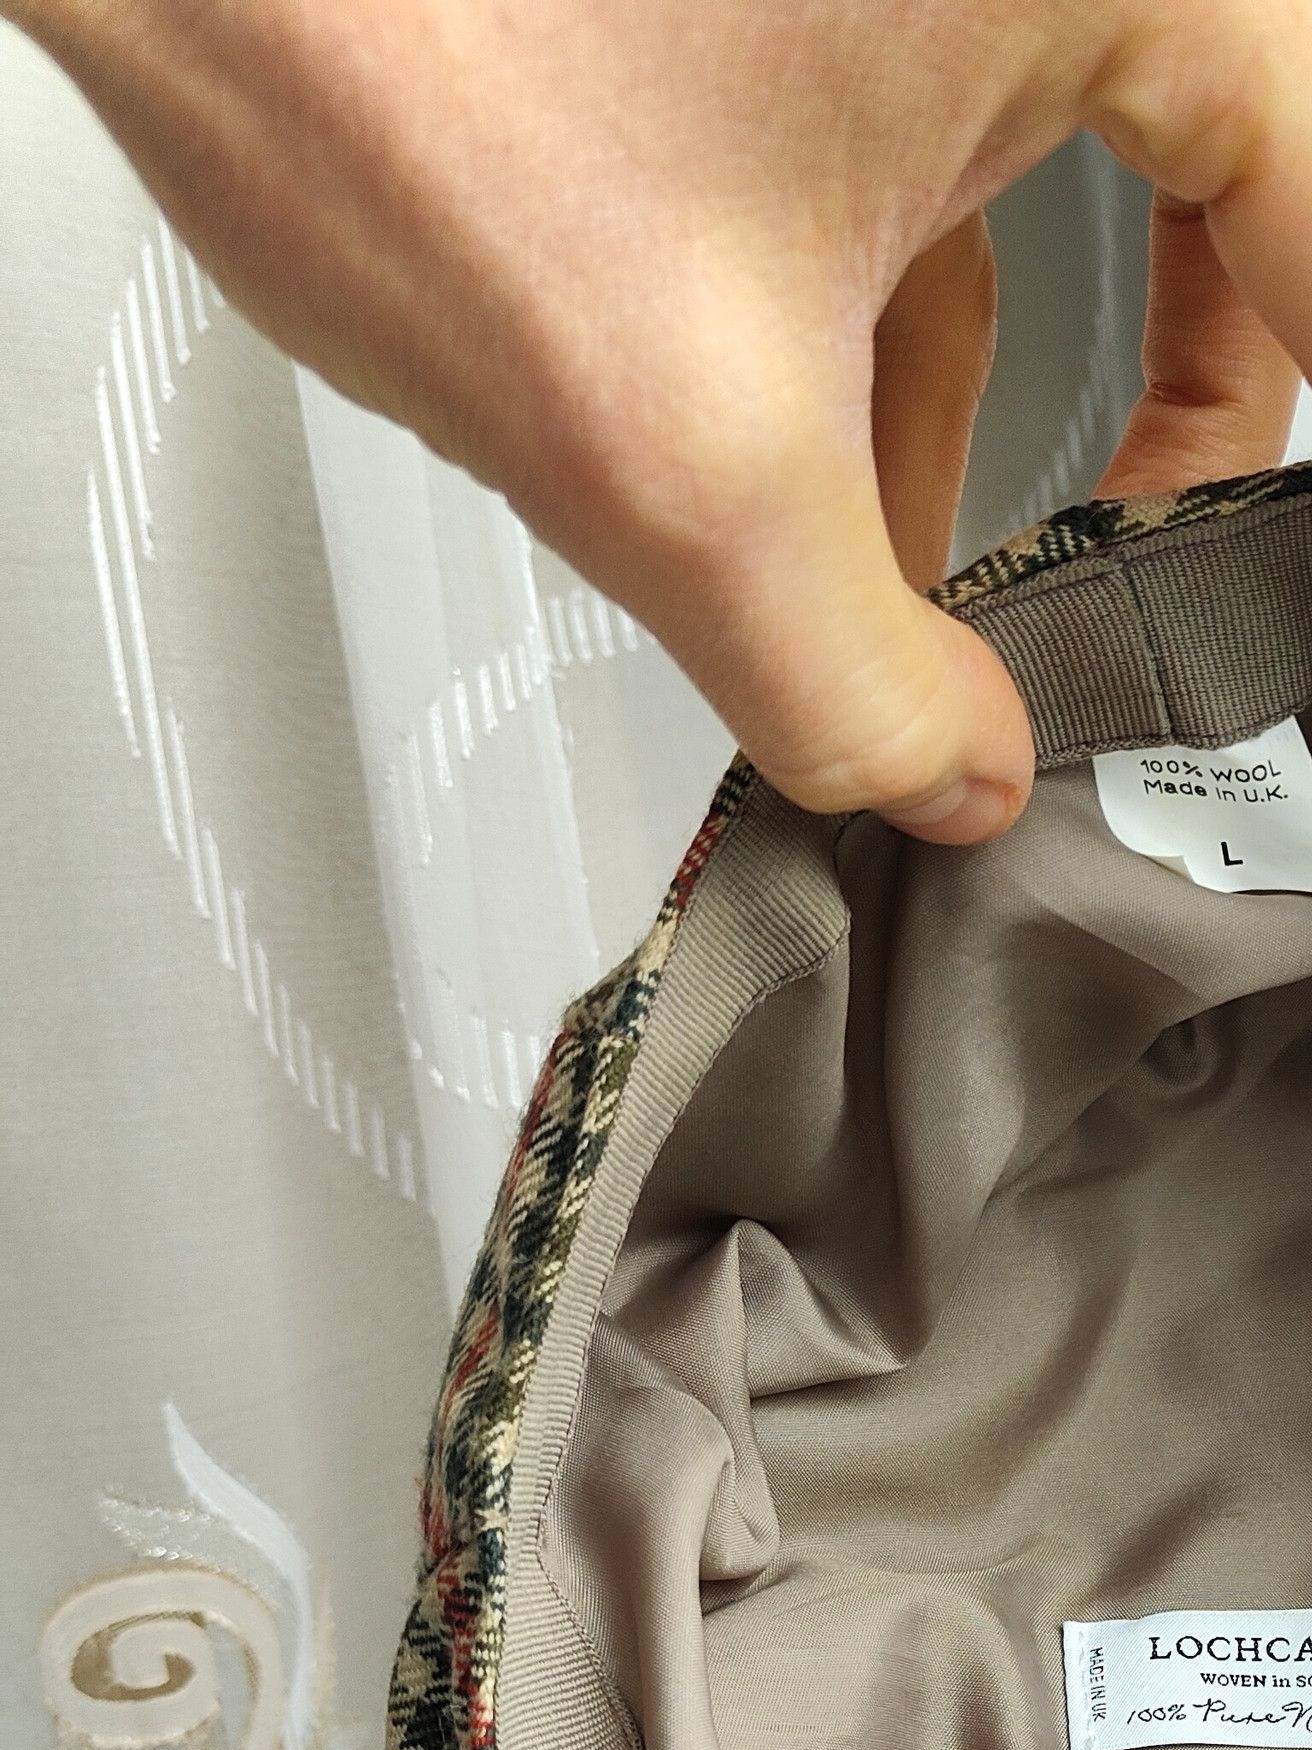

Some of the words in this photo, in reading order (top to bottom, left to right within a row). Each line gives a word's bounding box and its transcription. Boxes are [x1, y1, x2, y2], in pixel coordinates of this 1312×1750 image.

[1140, 759, 1203, 777] 100%
[1210, 760, 1281, 782] WOOL
[1144, 780, 1207, 797] Made
[1244, 785, 1288, 802] U.K.
[1220, 841, 1243, 866] L
[1089, 1647, 1105, 1683] MADE
[1200, 1673, 1266, 1687] WOVEN
[1271, 1675, 1291, 1688] in
[1090, 1685, 1106, 1701] IN
[1091, 1702, 1107, 1722] UK
[1127, 1704, 1186, 1724] 100%
[1193, 1698, 1286, 1724] Pure
